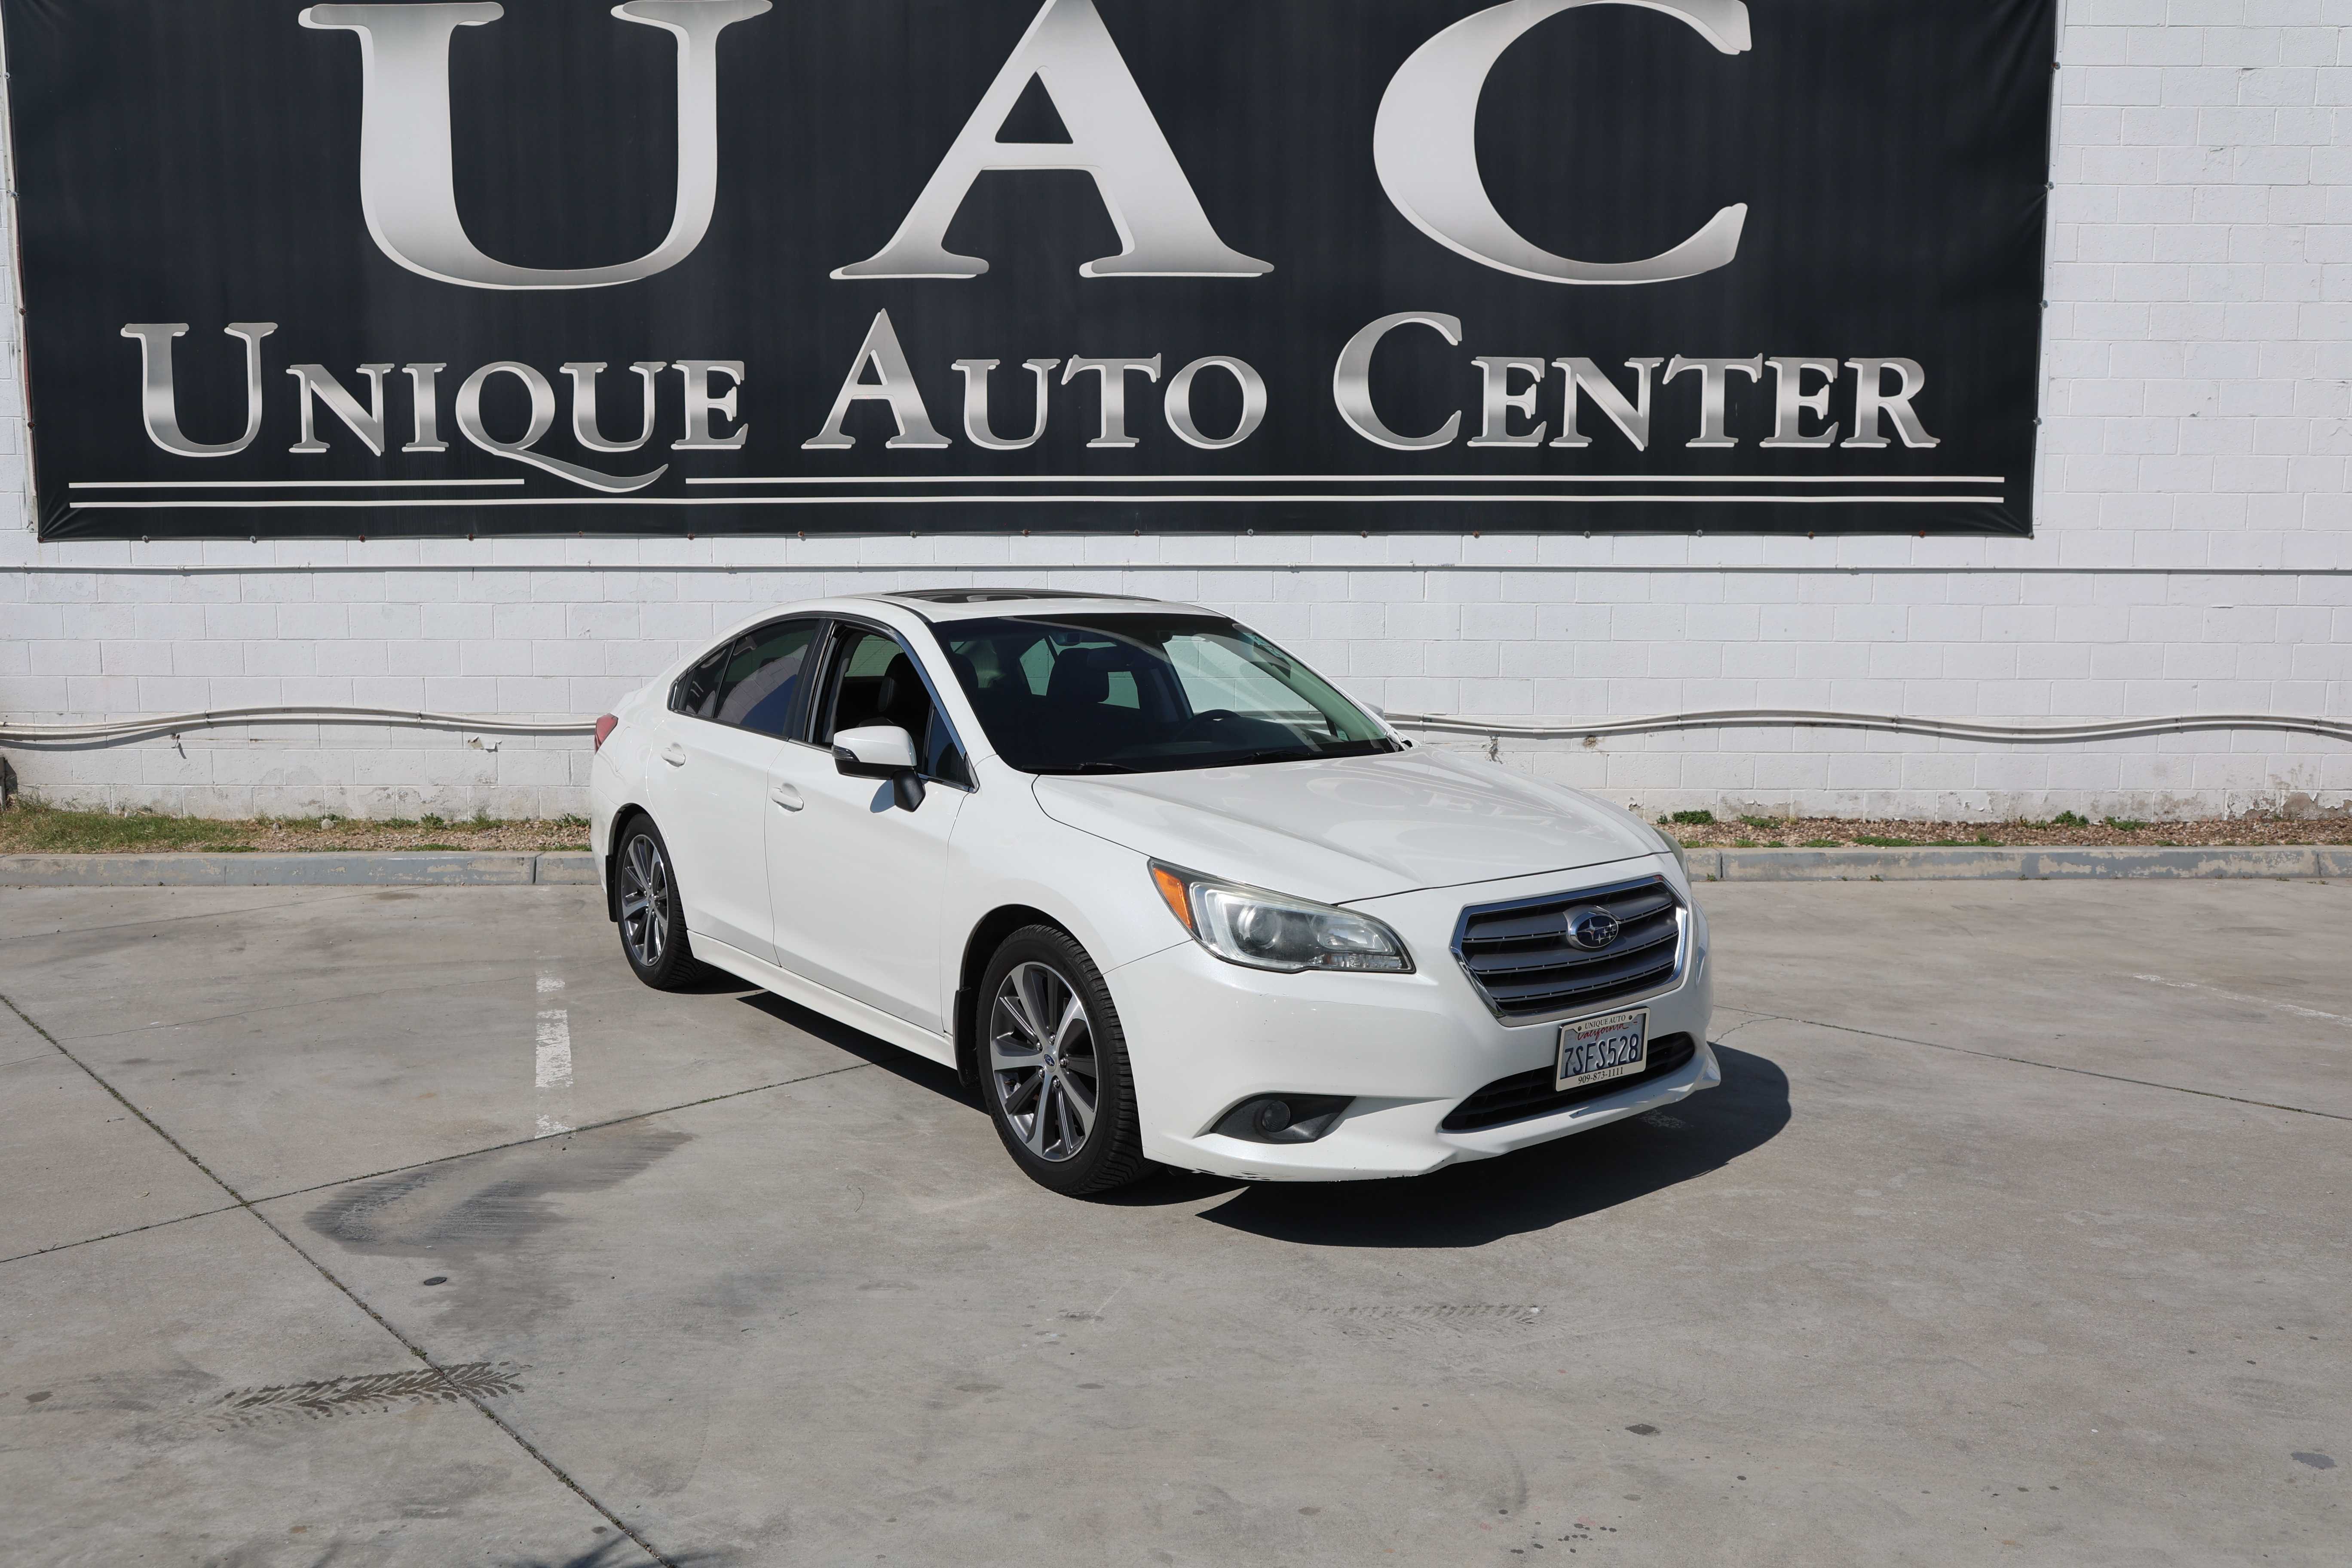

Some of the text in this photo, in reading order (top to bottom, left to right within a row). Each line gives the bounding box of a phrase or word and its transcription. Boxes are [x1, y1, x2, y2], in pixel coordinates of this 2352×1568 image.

[298, 0, 1753, 291] UAC
[120, 308, 1941, 494] UNIQUE AUTO CENTER
[1585, 1015, 1626, 1029] UNIQUE AUTO
[1578, 1067, 1623, 1084] 909-873-1111
